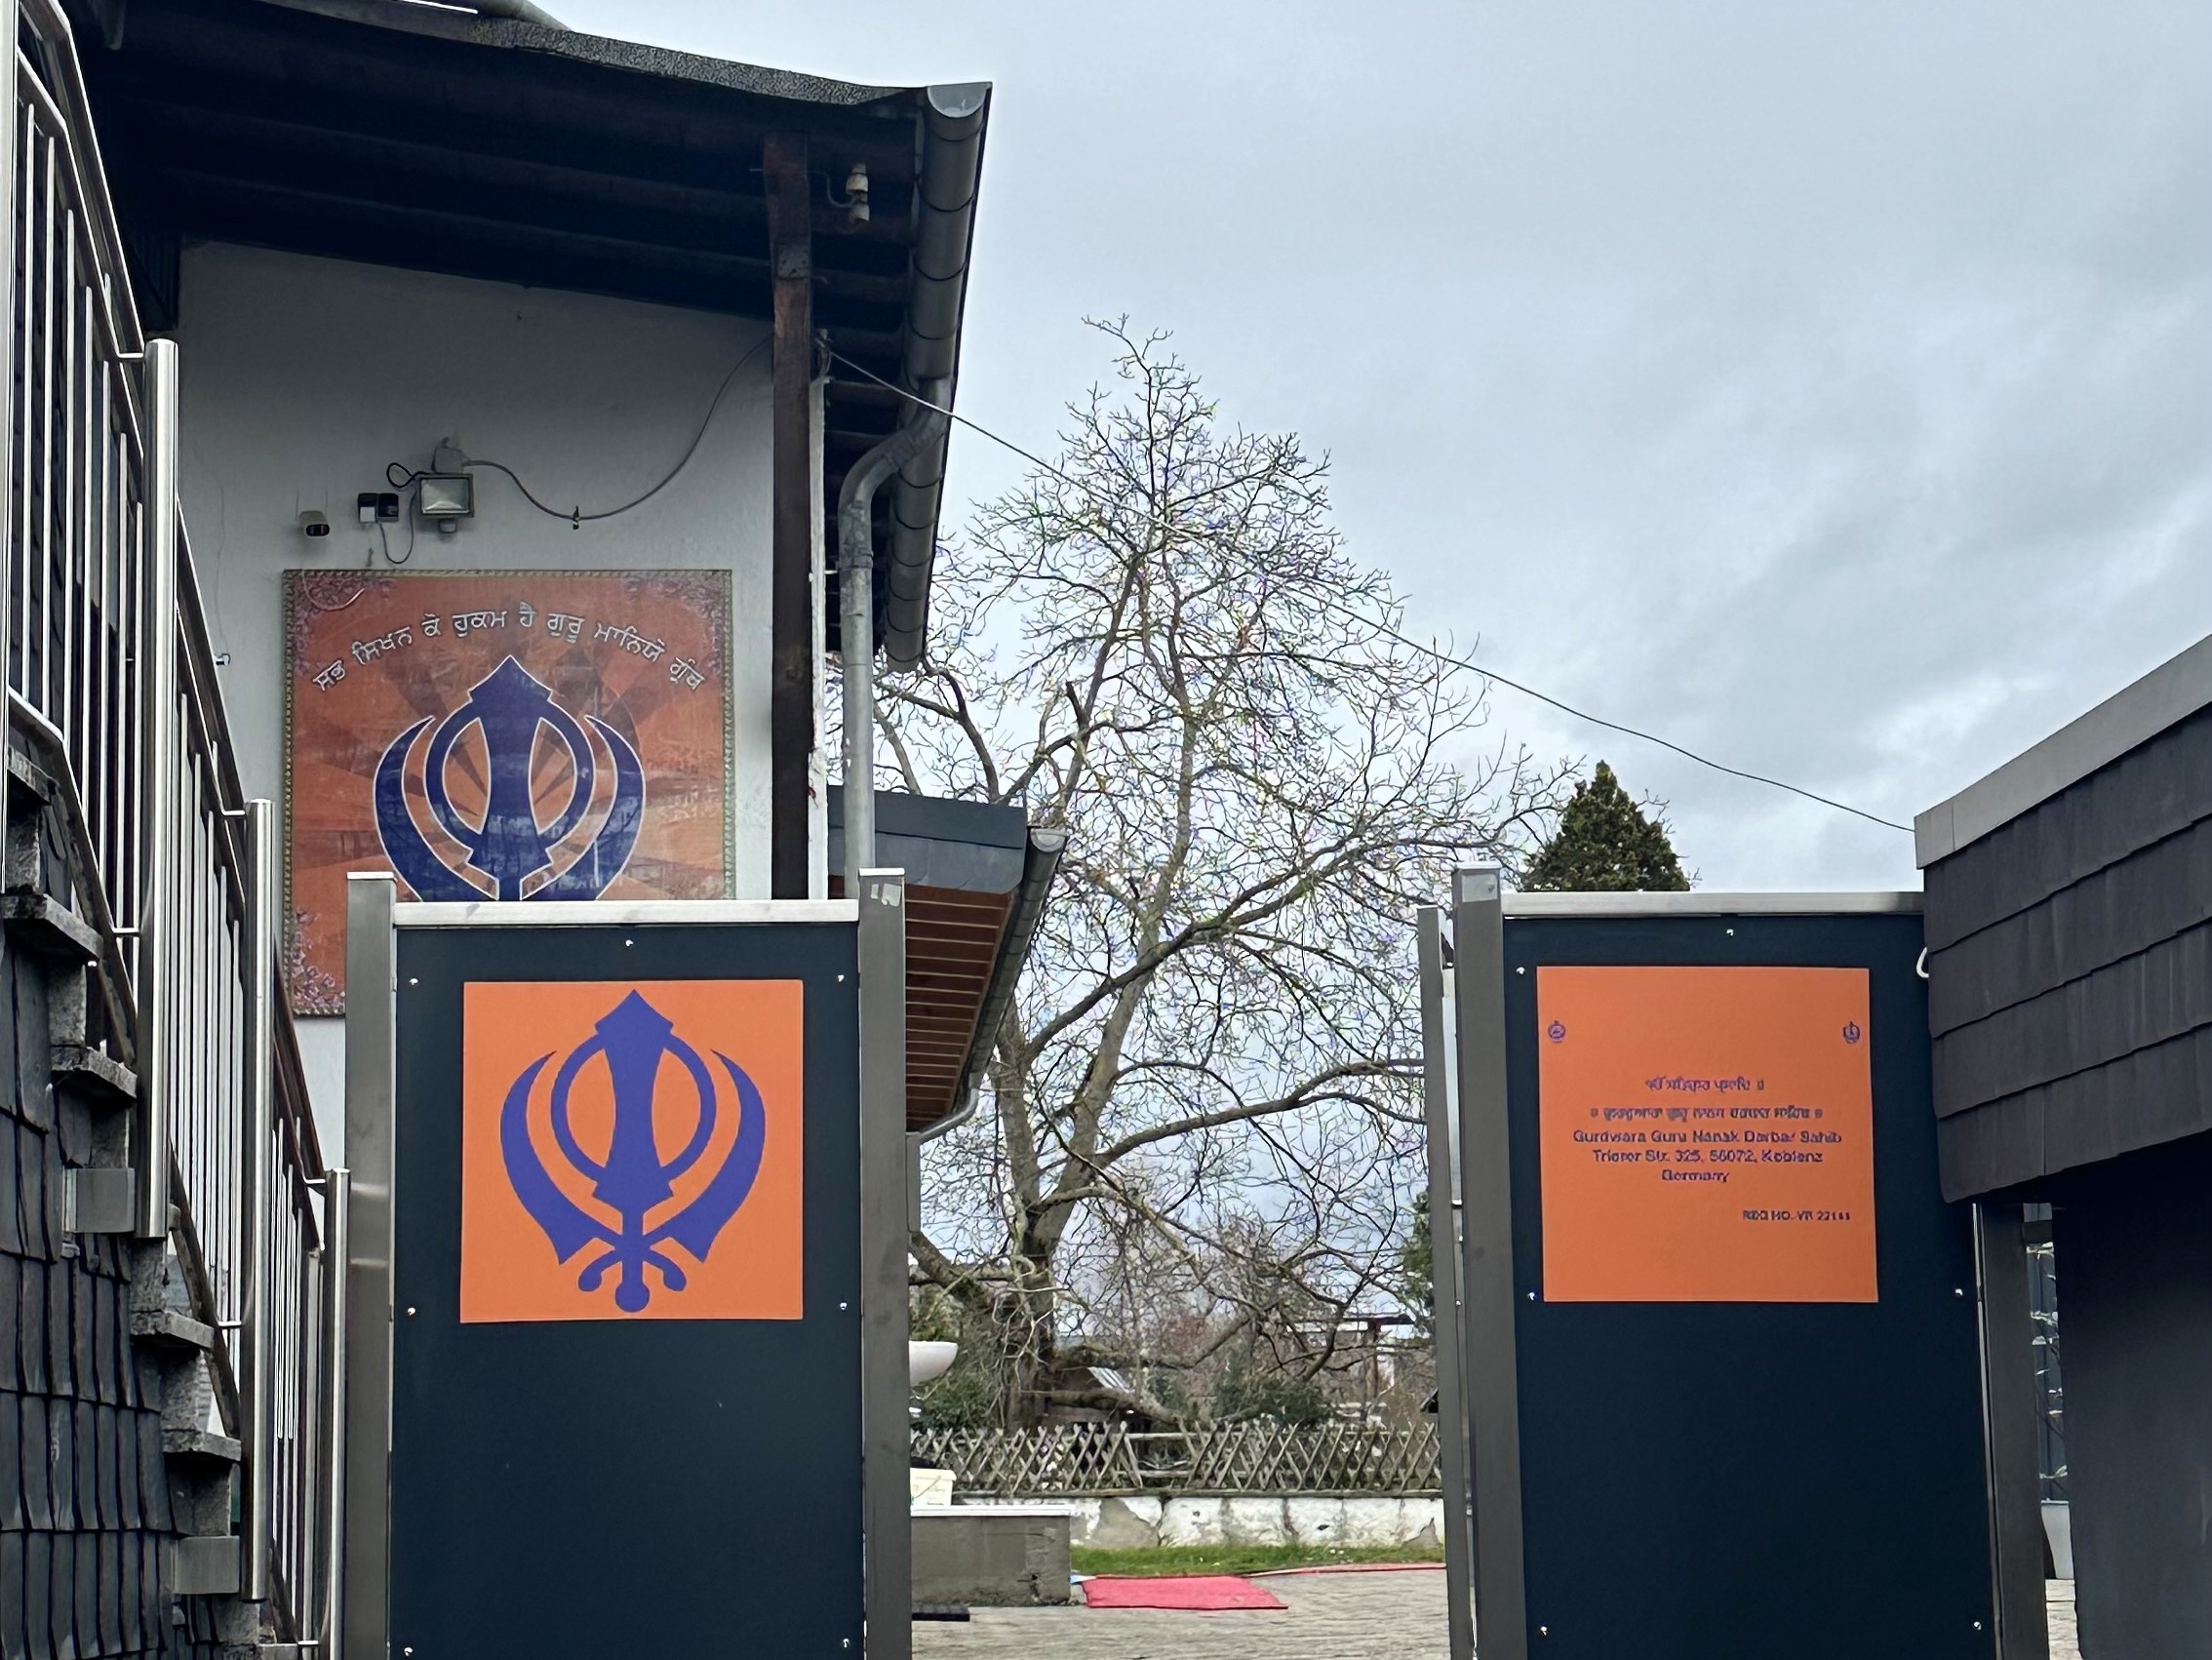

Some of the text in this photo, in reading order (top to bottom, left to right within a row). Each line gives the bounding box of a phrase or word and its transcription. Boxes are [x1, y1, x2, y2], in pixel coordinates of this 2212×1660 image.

[453, 611, 508, 637] ਹੁਕਮ
[519, 601, 537, 628] ਹੈ
[546, 613, 586, 644] ਗੁਰੂ
[1573, 1129, 1646, 1143] Gurdwara
[1650, 1129, 1687, 1143] Guru
[1692, 1129, 1739, 1143] Nanak
[1744, 1129, 1796, 1143] Darbar
[1762, 1148, 1824, 1163] Koblenz
[1661, 1169, 1730, 1184] Germany
